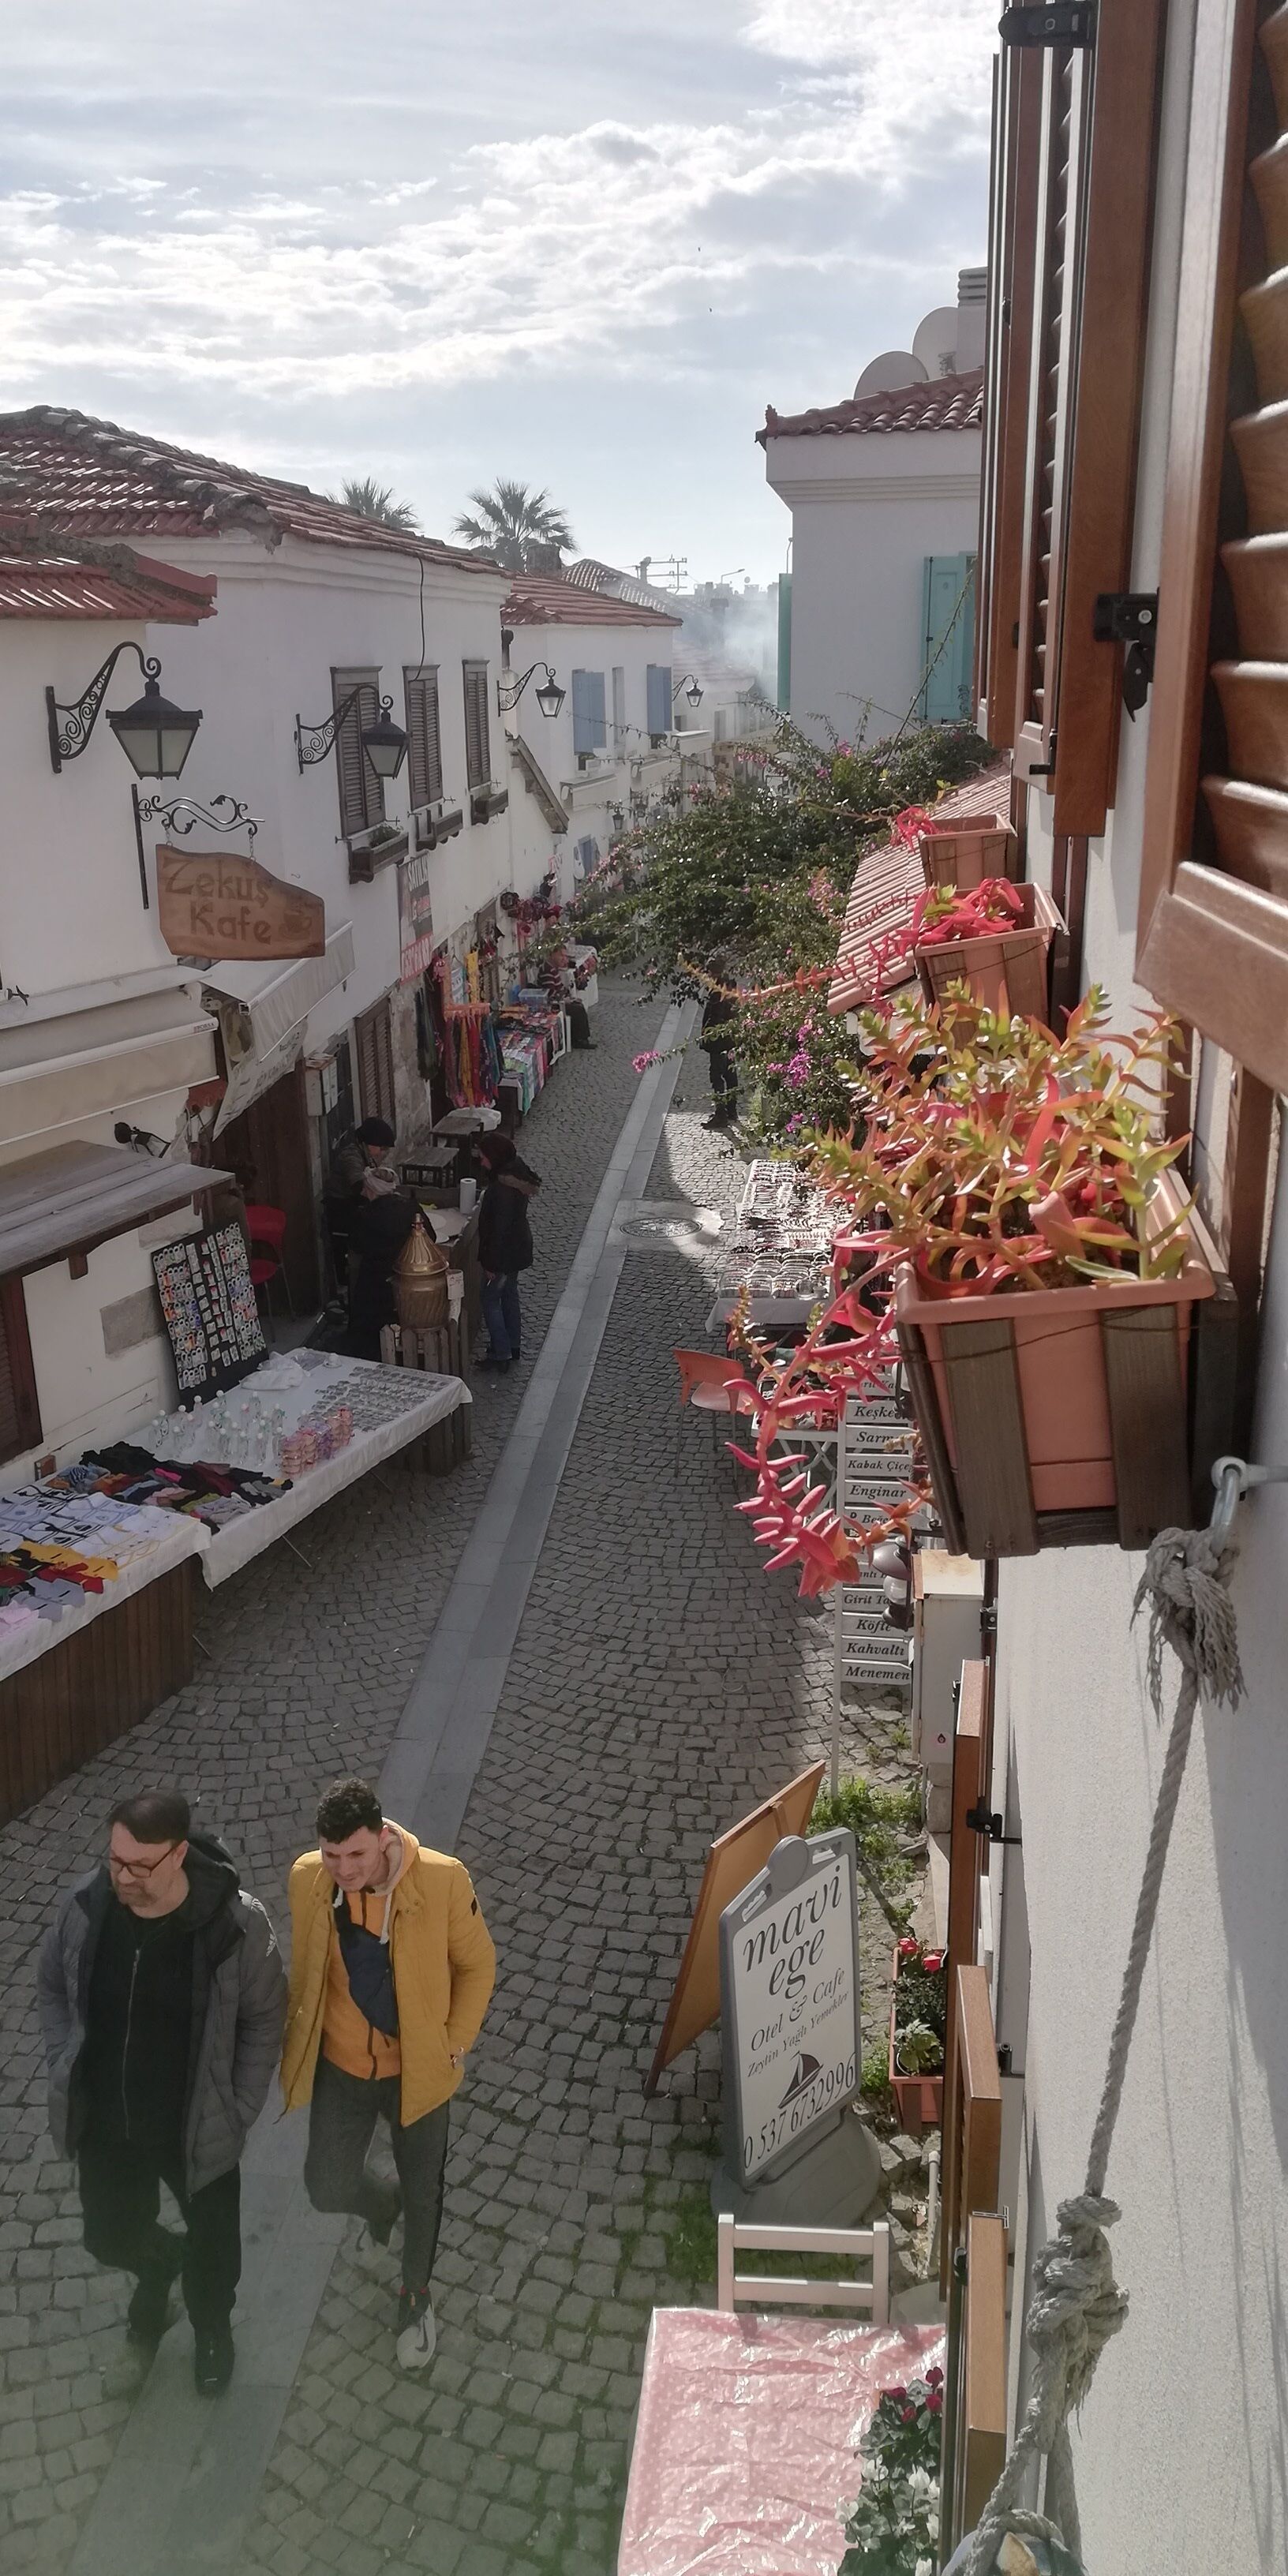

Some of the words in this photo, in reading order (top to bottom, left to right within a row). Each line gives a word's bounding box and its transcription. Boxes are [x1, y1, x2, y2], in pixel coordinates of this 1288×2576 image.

[163, 857, 269, 908] Zekuş
[190, 898, 271, 945] Kafe
[854, 1406, 895, 1420] Keşke
[856, 1431, 897, 1443] Sarm
[848, 1460, 883, 1469] Kabak
[886, 1460, 912, 1473] Çiçe
[850, 1485, 907, 1500] Enginar
[844, 1594, 872, 1604] Girit
[876, 1595, 893, 1604] Ta
[856, 1619, 892, 1634] Köfte
[846, 1642, 905, 1656] Kahvaltı
[845, 1666, 910, 1680] Menemen
[743, 1865, 842, 1972] mavi
[769, 1929, 825, 1999] ege
[751, 2013, 783, 2051] Otel
[789, 1994, 807, 2022] &
[813, 1968, 845, 2005] Cafe
[748, 2046, 778, 2078] Zeytin
[783, 2024, 807, 2052] Yağlı
[810, 1990, 849, 2030] Yemekler
[744, 2136, 753, 2169] 0
[758, 2109, 788, 2160] 537
[791, 2052, 856, 2132] 6732996
